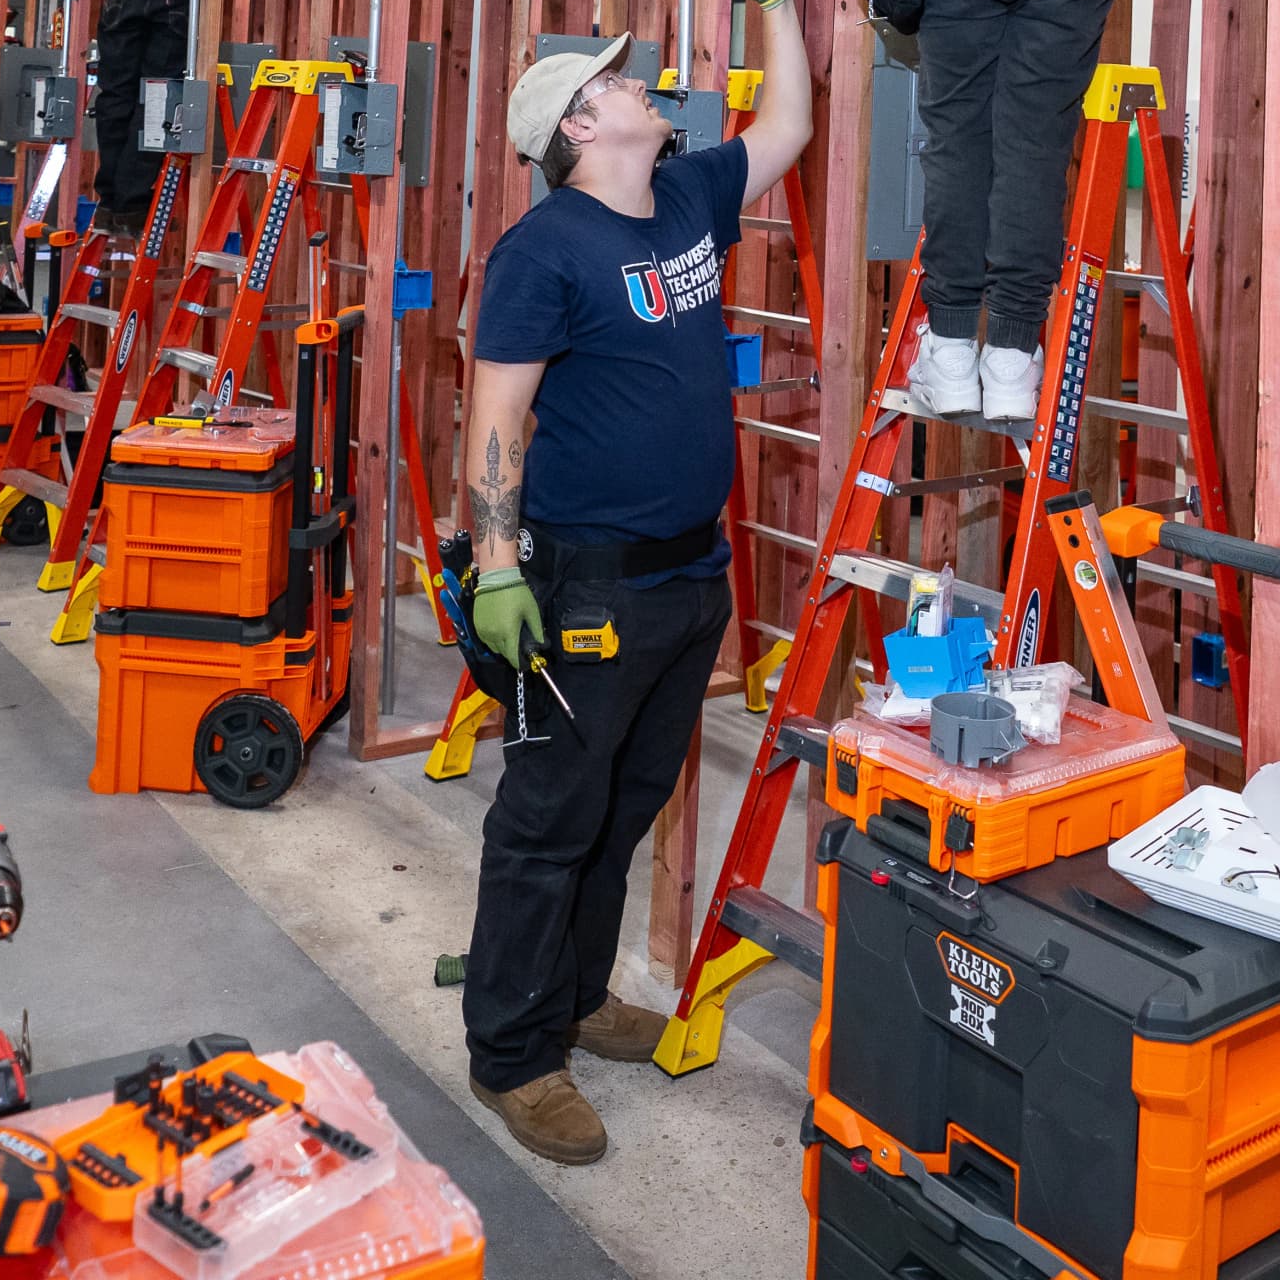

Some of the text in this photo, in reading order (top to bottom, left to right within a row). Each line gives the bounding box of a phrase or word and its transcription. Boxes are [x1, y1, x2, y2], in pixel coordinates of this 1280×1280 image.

[119, 320, 134, 360] WERNER
[948, 942, 1000, 982] KLEIN
[948, 957, 1000, 997] TOOLS
[960, 1009, 984, 1034] BOX
[961, 994, 985, 1019] MOD
